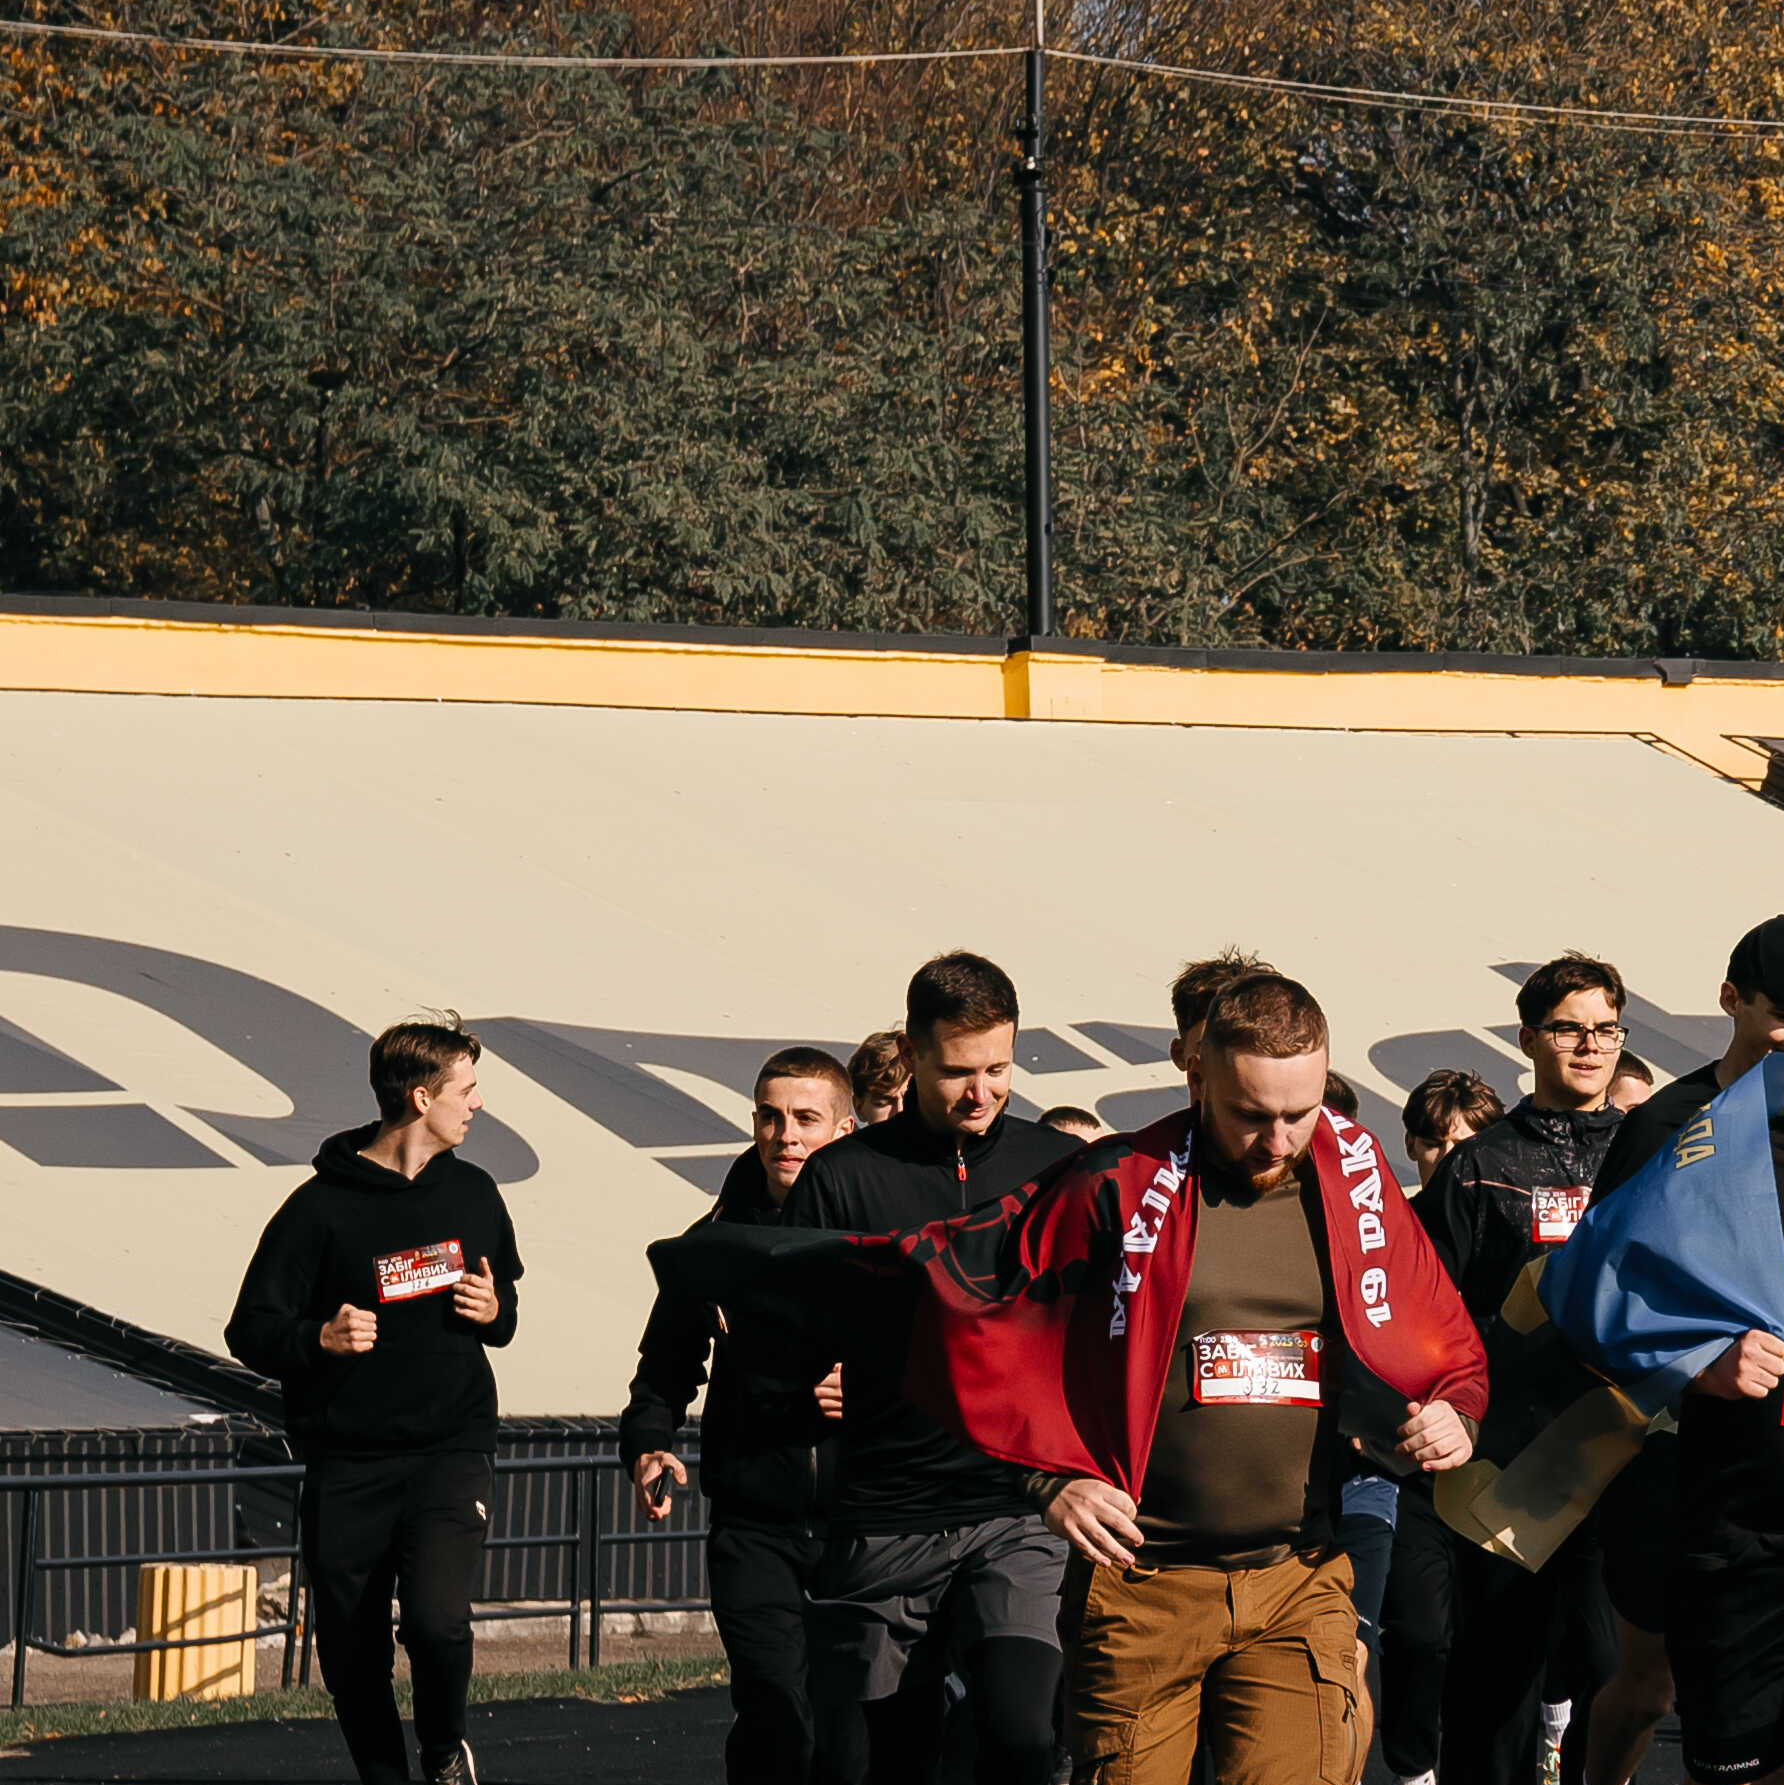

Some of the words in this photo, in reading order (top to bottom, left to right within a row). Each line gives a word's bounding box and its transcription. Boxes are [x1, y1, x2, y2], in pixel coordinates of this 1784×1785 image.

[1537, 1196, 1582, 1209] ЗАБІГ
[378, 1257, 415, 1276] ЗАБІГ
[1359, 1266, 1393, 1329] 19
